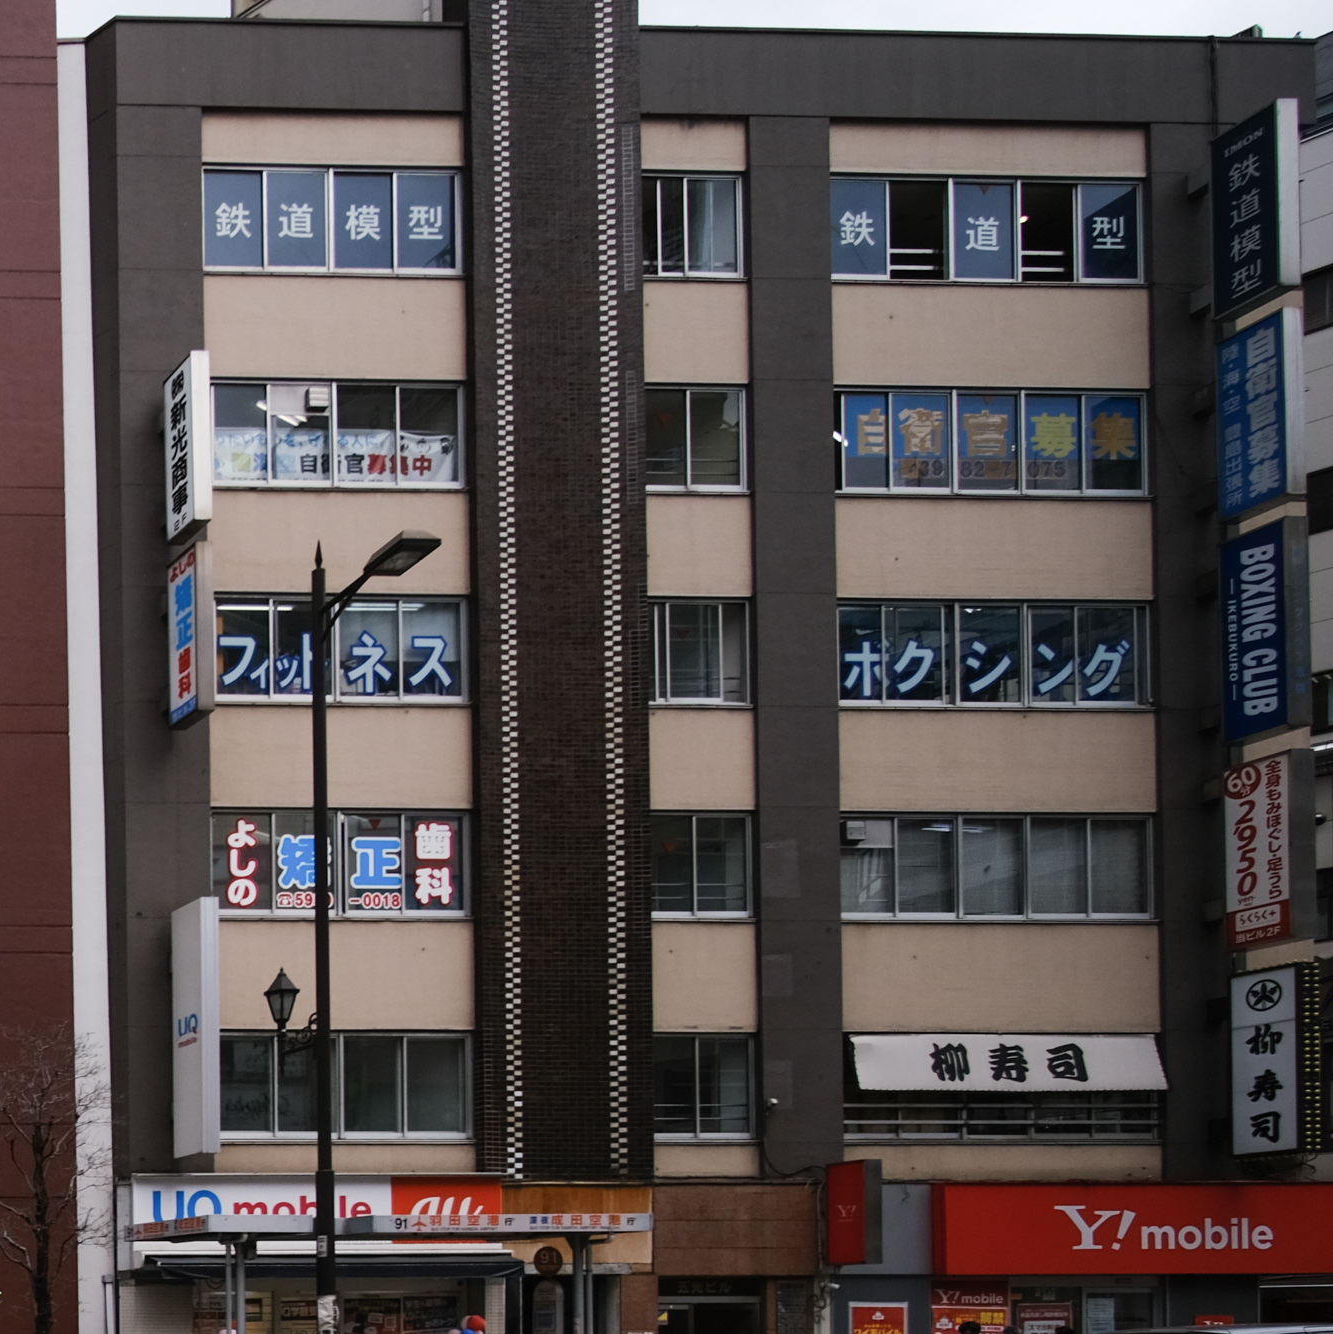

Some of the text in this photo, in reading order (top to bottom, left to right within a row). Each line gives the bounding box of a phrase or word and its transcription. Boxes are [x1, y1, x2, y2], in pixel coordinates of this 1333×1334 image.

[1224, 126, 1264, 159] IMON
[215, 203, 444, 241] 鉄道模型
[1228, 153, 1263, 299] 鉄道模型
[858, 407, 1137, 456] 自衛官募集
[1245, 326, 1280, 498] 自衛官募集
[1227, 600, 1239, 682] IKEBUKURO
[1240, 543, 1278, 716] BOXING CLUB
[842, 641, 1129, 697] ボクシング
[1233, 800, 1257, 897] 2,950
[1265, 760, 1283, 900] 全身もみほぐし・足うら
[227, 819, 258, 907] よしの
[415, 821, 454, 906] 歯科
[296, 892, 402, 909] 59-0018
[178, 1014, 198, 1036] UQ
[931, 1043, 1088, 1082] 柳寿司
[1246, 1024, 1283, 1143] 柳寿司
[394, 1217, 408, 1230] 91
[1140, 1218, 1273, 1250] mobile
[961, 1293, 1004, 1304] mobile
